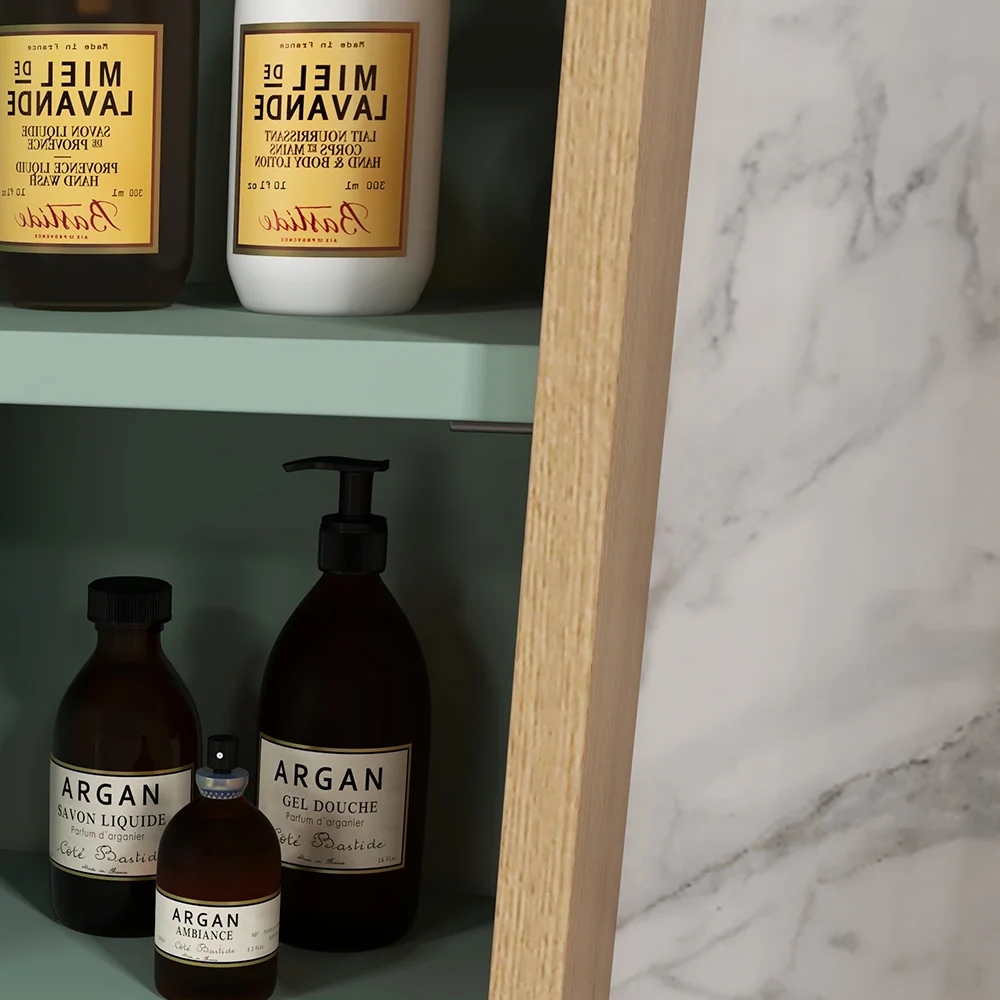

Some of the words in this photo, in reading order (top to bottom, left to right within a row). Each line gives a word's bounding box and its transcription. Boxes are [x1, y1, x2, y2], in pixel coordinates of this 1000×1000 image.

[274, 760, 383, 791] ARGAN
[61, 776, 159, 806] ARGAN
[282, 795, 308, 810] GEL
[313, 800, 378, 814] DOUCHE
[57, 804, 96, 825] SAVON
[101, 813, 166, 831] LIQUIDE
[285, 812, 313, 824] Parfum
[71, 826, 96, 838] Parfum
[311, 832, 387, 851] Bastide
[172, 907, 239, 928] ARGAN
[176, 926, 233, 941] AMBIANCE
[196, 943, 236, 954] Bastide
